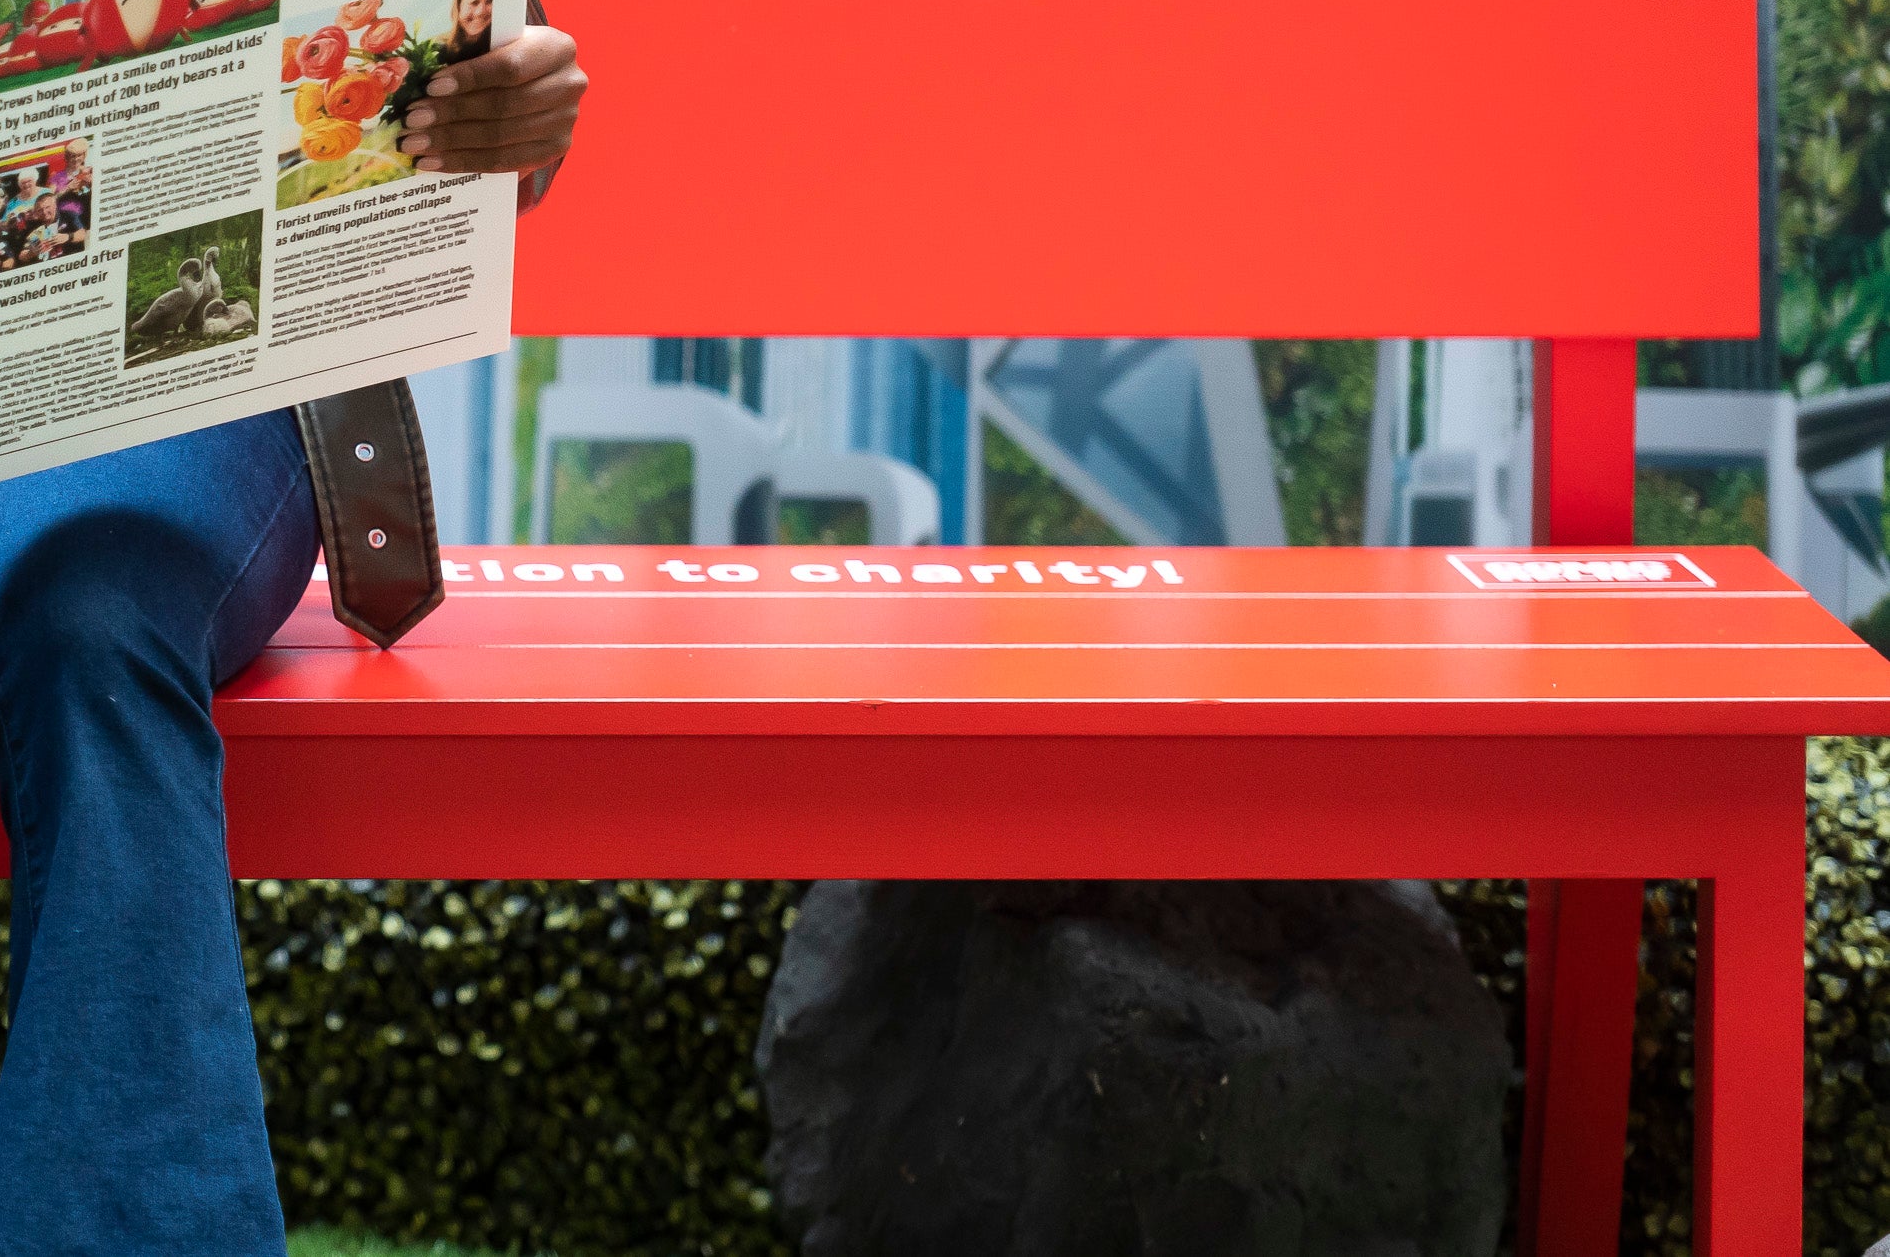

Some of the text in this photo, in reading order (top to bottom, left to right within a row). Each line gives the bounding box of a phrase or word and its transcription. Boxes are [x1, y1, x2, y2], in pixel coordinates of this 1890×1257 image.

[36, 86, 66, 101] hope
[70, 81, 83, 93] to
[86, 73, 108, 91] put
[111, 72, 119, 82] a
[122, 61, 156, 79] smile
[159, 58, 175, 70] on
[178, 40, 233, 65] troubled
[5, 117, 19, 130] by
[23, 103, 74, 124] handing
[78, 94, 99, 110] out
[102, 89, 116, 104] of
[119, 83, 140, 99] 200
[143, 75, 179, 93] teddy
[182, 66, 217, 83] bears
[220, 60, 234, 74] at
[237, 59, 244, 69] a
[23, 125, 65, 143] refuge
[69, 120, 81, 132] in
[84, 100, 159, 128] Nottingham
[275, 194, 451, 246] as dwindling populations collapse
[276, 213, 311, 230] Florist
[313, 203, 350, 221] unveils
[353, 196, 376, 210] first
[379, 183, 436, 204] bee-saving
[38, 254, 87, 278] rescued
[91, 248, 124, 265] after
[0, 284, 46, 307] washed
[49, 279, 77, 294] over
[80, 270, 108, 286] weir
[657, 559, 759, 583] to
[789, 559, 1184, 589] charity!
